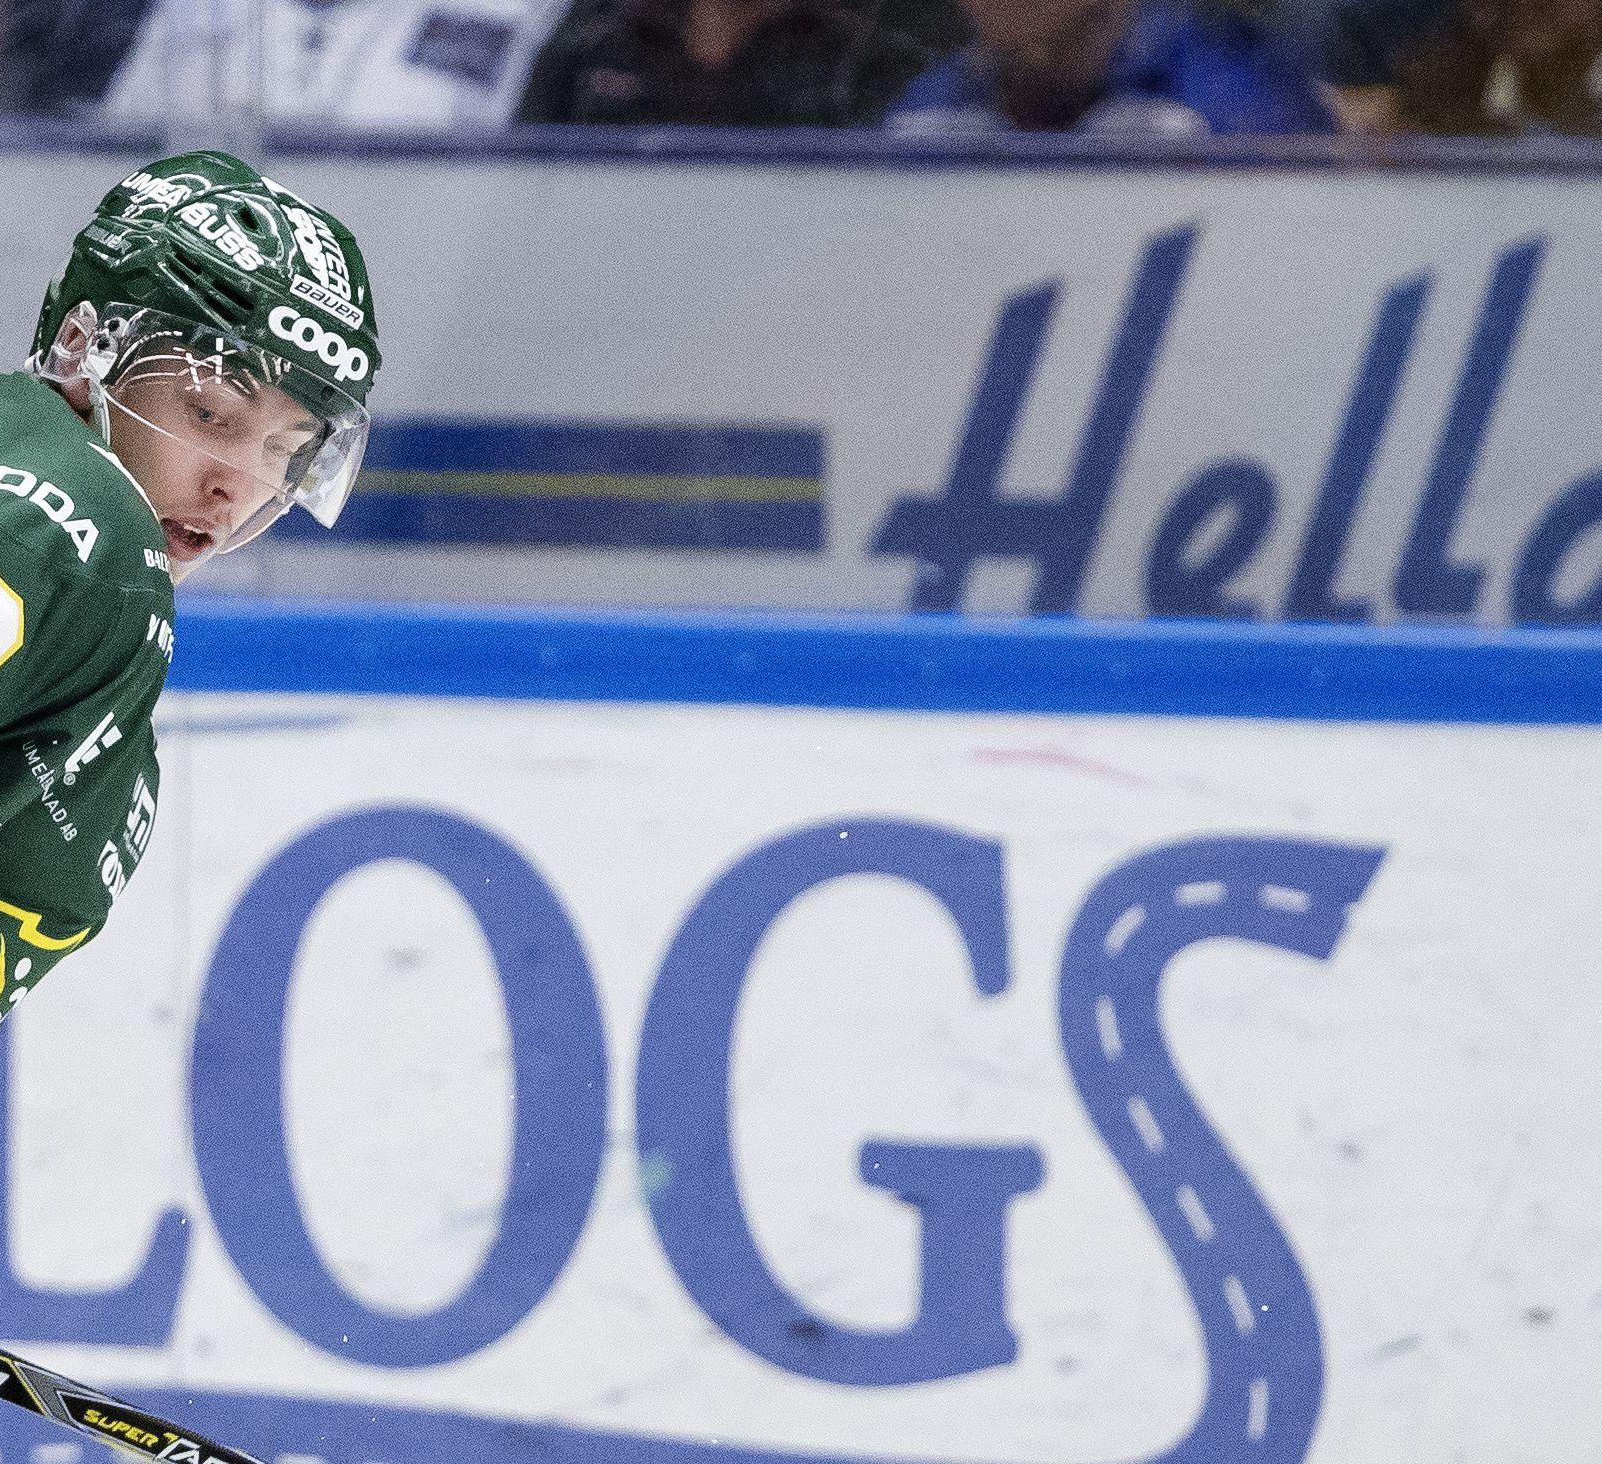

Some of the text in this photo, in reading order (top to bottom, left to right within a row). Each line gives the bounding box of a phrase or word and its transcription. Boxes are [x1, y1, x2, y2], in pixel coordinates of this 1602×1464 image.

[178, 201, 264, 271] BUSS
[268, 306, 368, 382] coop
[84, 1409, 159, 1448] SUPER
